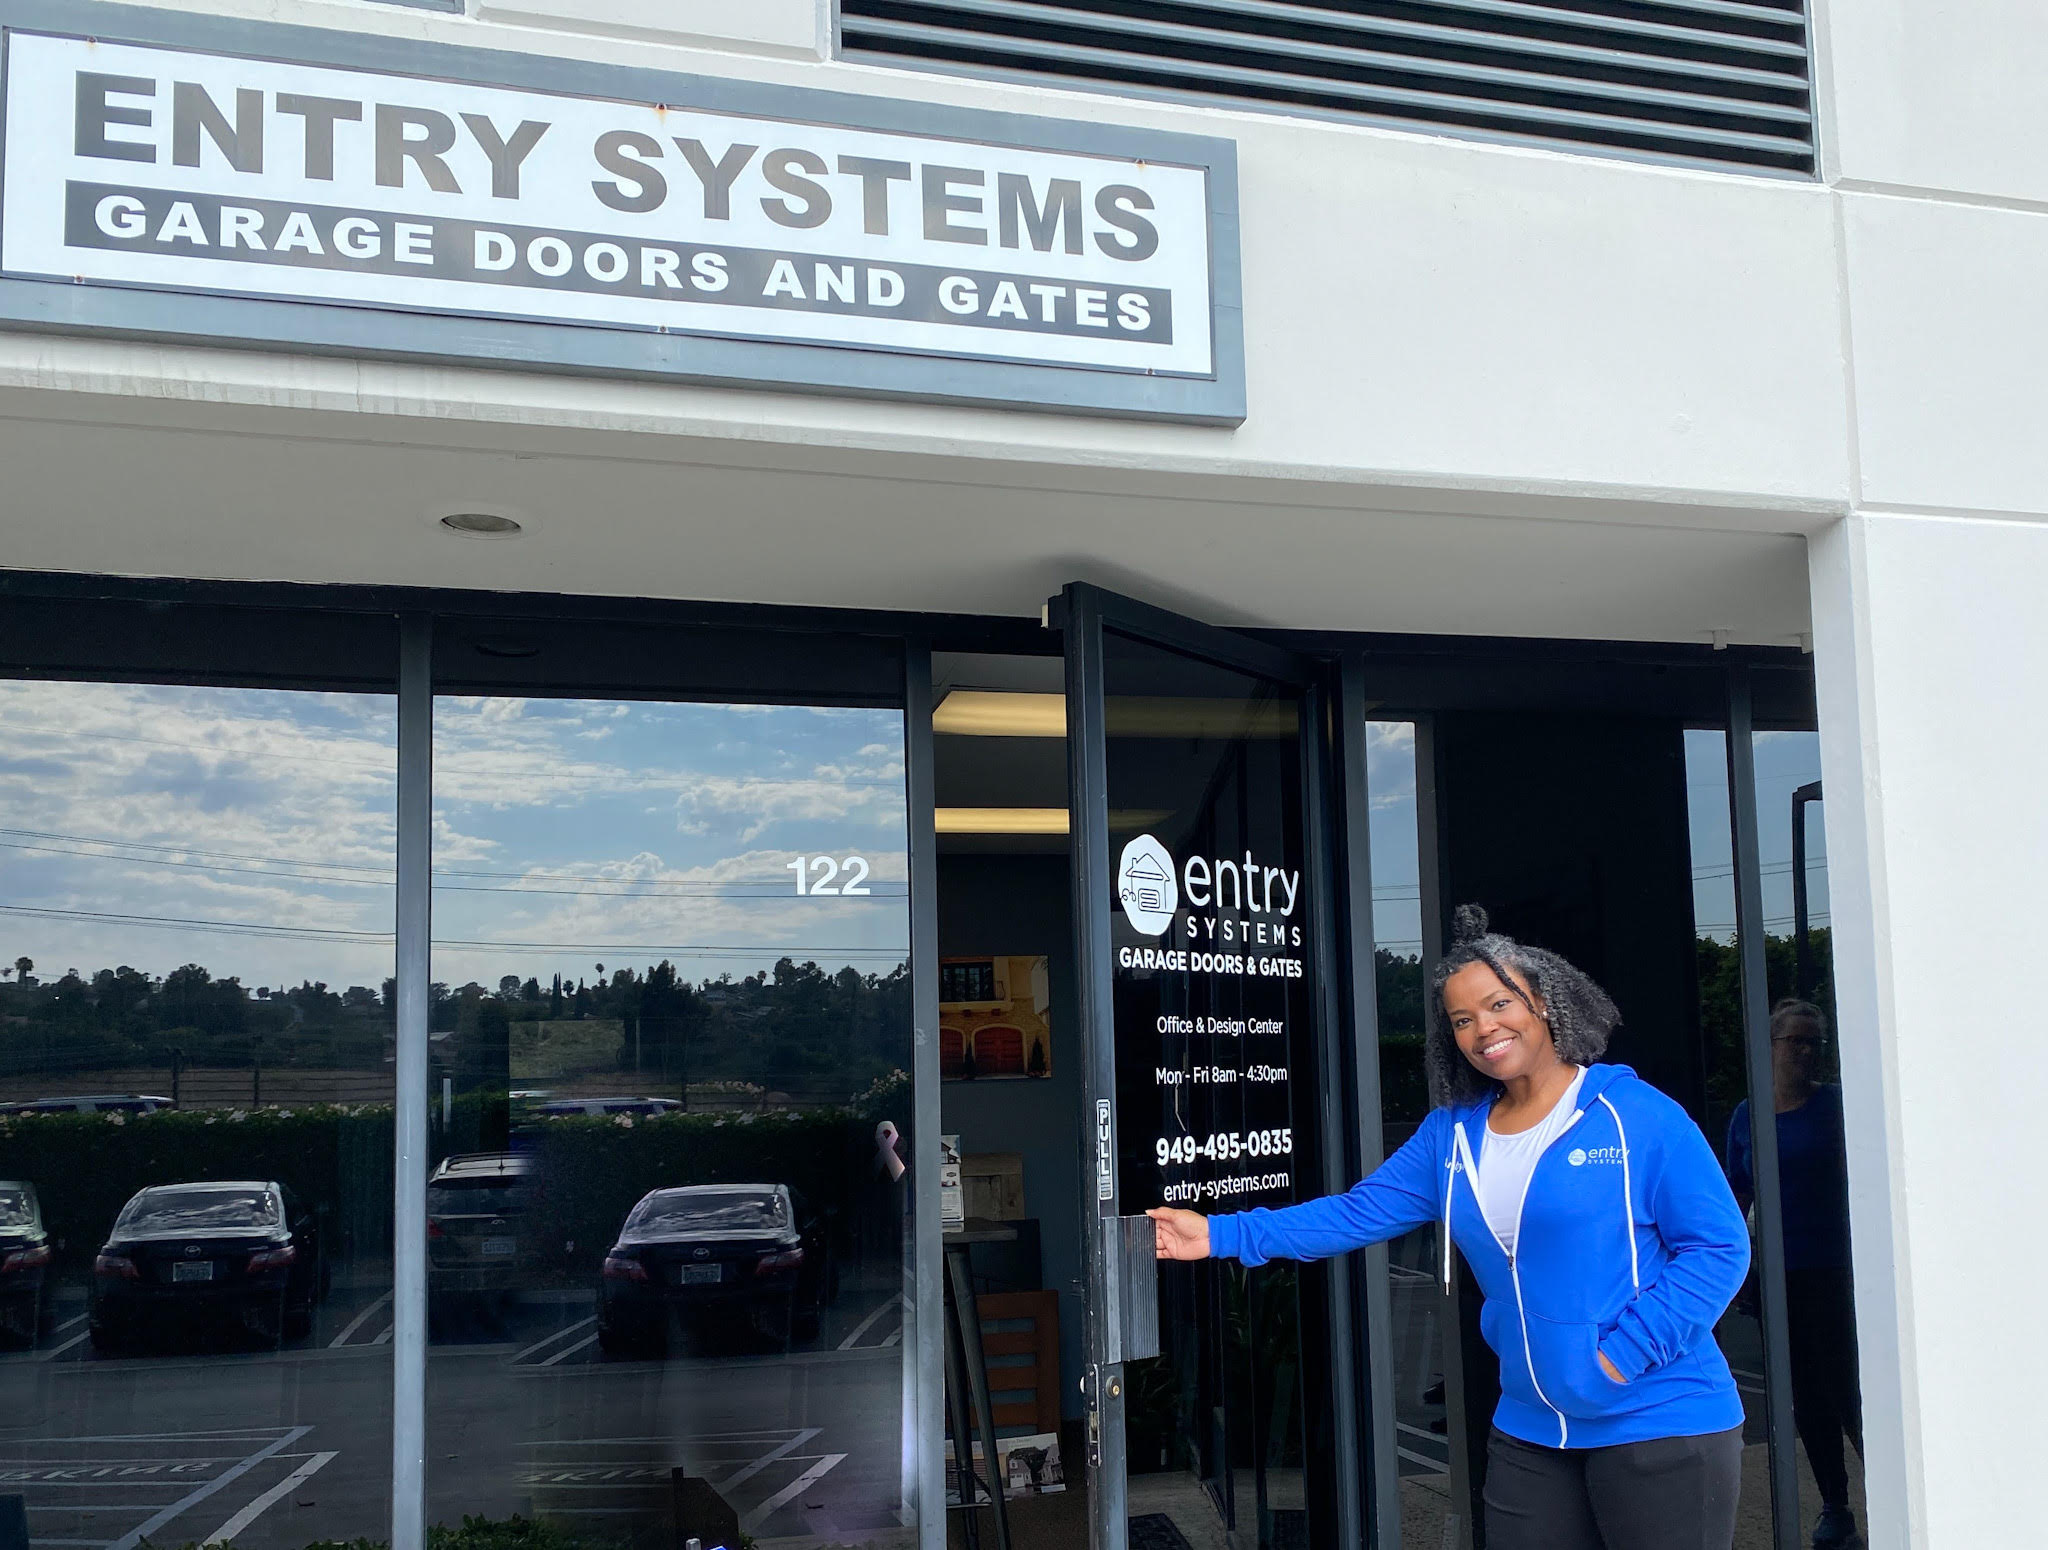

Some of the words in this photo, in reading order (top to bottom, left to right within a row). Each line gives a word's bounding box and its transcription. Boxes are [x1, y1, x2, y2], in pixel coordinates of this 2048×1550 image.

[75, 70, 552, 200] ENTRY
[592, 130, 1159, 262] SYSTEMS
[94, 195, 435, 264] GARAGE
[474, 231, 729, 292] DOORS
[762, 259, 905, 307] AND
[938, 276, 1152, 332] GATES
[786, 855, 871, 896] 122
[1184, 850, 1299, 916] entry
[1186, 915, 1301, 946] SYSTEMS
[1119, 946, 1188, 971] GARAGE
[1191, 951, 1244, 974] DOORS
[1246, 956, 1257, 975] &
[1259, 957, 1303, 978] GATES
[1156, 1016, 1194, 1034] Office
[1195, 1017, 1205, 1034] &
[1207, 1017, 1246, 1037] Design
[1248, 1018, 1284, 1034] Center
[1155, 1067, 1182, 1085] Mon
[1193, 1066, 1210, 1083] Fri
[1211, 1066, 1237, 1083] 8am
[1246, 1065, 1288, 1083] 4:30pm
[1099, 1107, 1110, 1176] PULL
[1155, 1128, 1293, 1166] 949-495-0835
[1163, 1172, 1290, 1202] entry-systems.com
